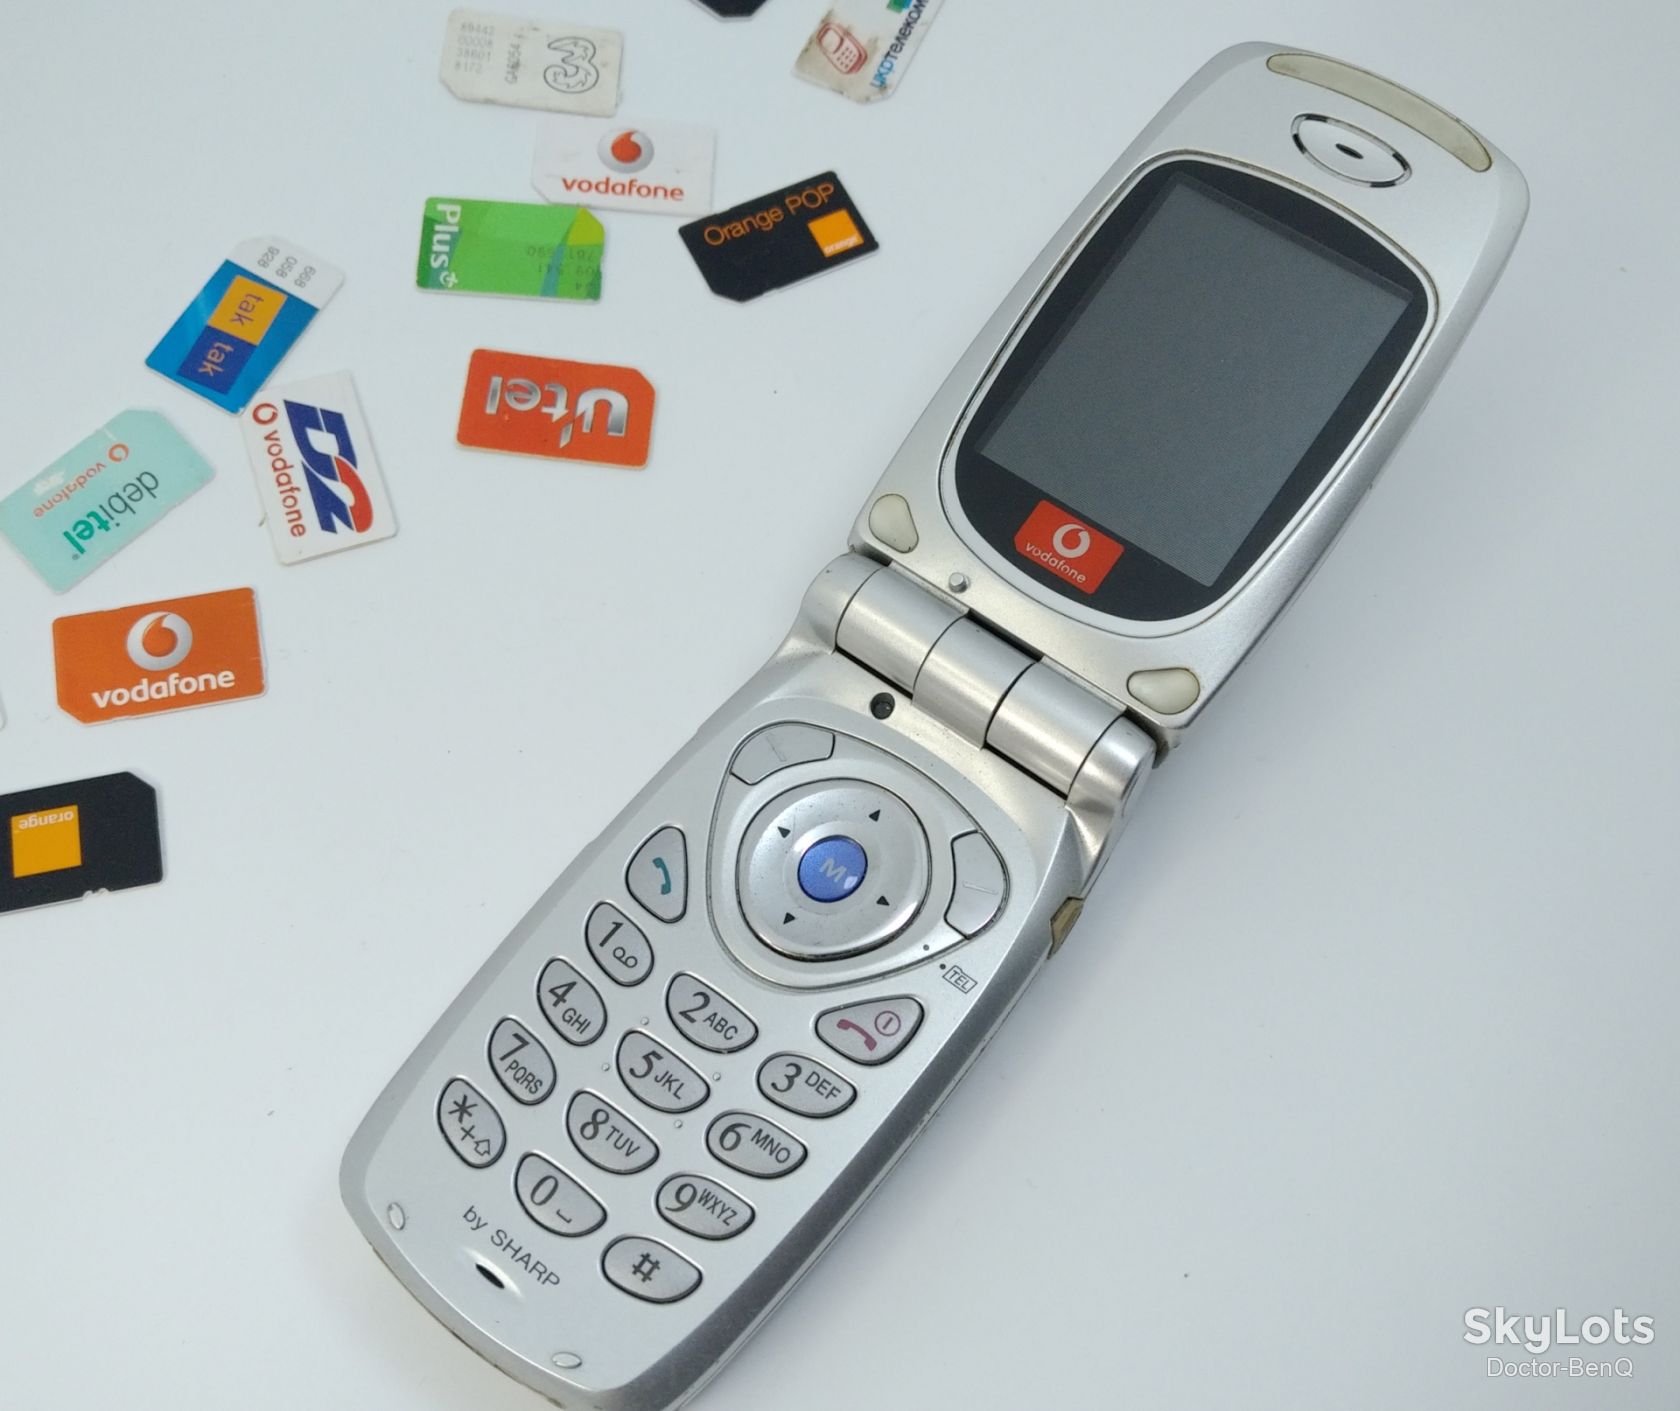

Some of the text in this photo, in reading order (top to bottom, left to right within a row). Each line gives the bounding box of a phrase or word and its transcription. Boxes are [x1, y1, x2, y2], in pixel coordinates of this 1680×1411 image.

[561, 177, 685, 201] vodafone
[703, 183, 835, 246] Orange POP
[430, 204, 461, 269] Plus
[229, 292, 264, 327] tak
[198, 341, 234, 377] tak
[33, 462, 107, 518] vodafone
[263, 430, 307, 537] vodafone
[62, 471, 159, 554] debitel
[1025, 543, 1087, 583] vodafone
[91, 670, 236, 709] vodafone
[19, 811, 74, 830] orange
[819, 857, 847, 883] M
[598, 921, 624, 948] 1
[950, 970, 971, 991] TEL
[548, 981, 592, 1035] 4 GHI
[678, 991, 738, 1041] 2 ABC
[499, 1032, 543, 1095] 7 PQRS
[629, 1050, 685, 1100] 5 JKL
[770, 1062, 841, 1100] 3 DEF
[580, 1108, 641, 1157] 8 TUV
[719, 1122, 791, 1164] 6 MNO
[530, 1175, 559, 1206] 0
[665, 1183, 738, 1227] 9 WXYZ
[462, 1205, 560, 1288] by SHARP
[631, 1252, 661, 1283] #
